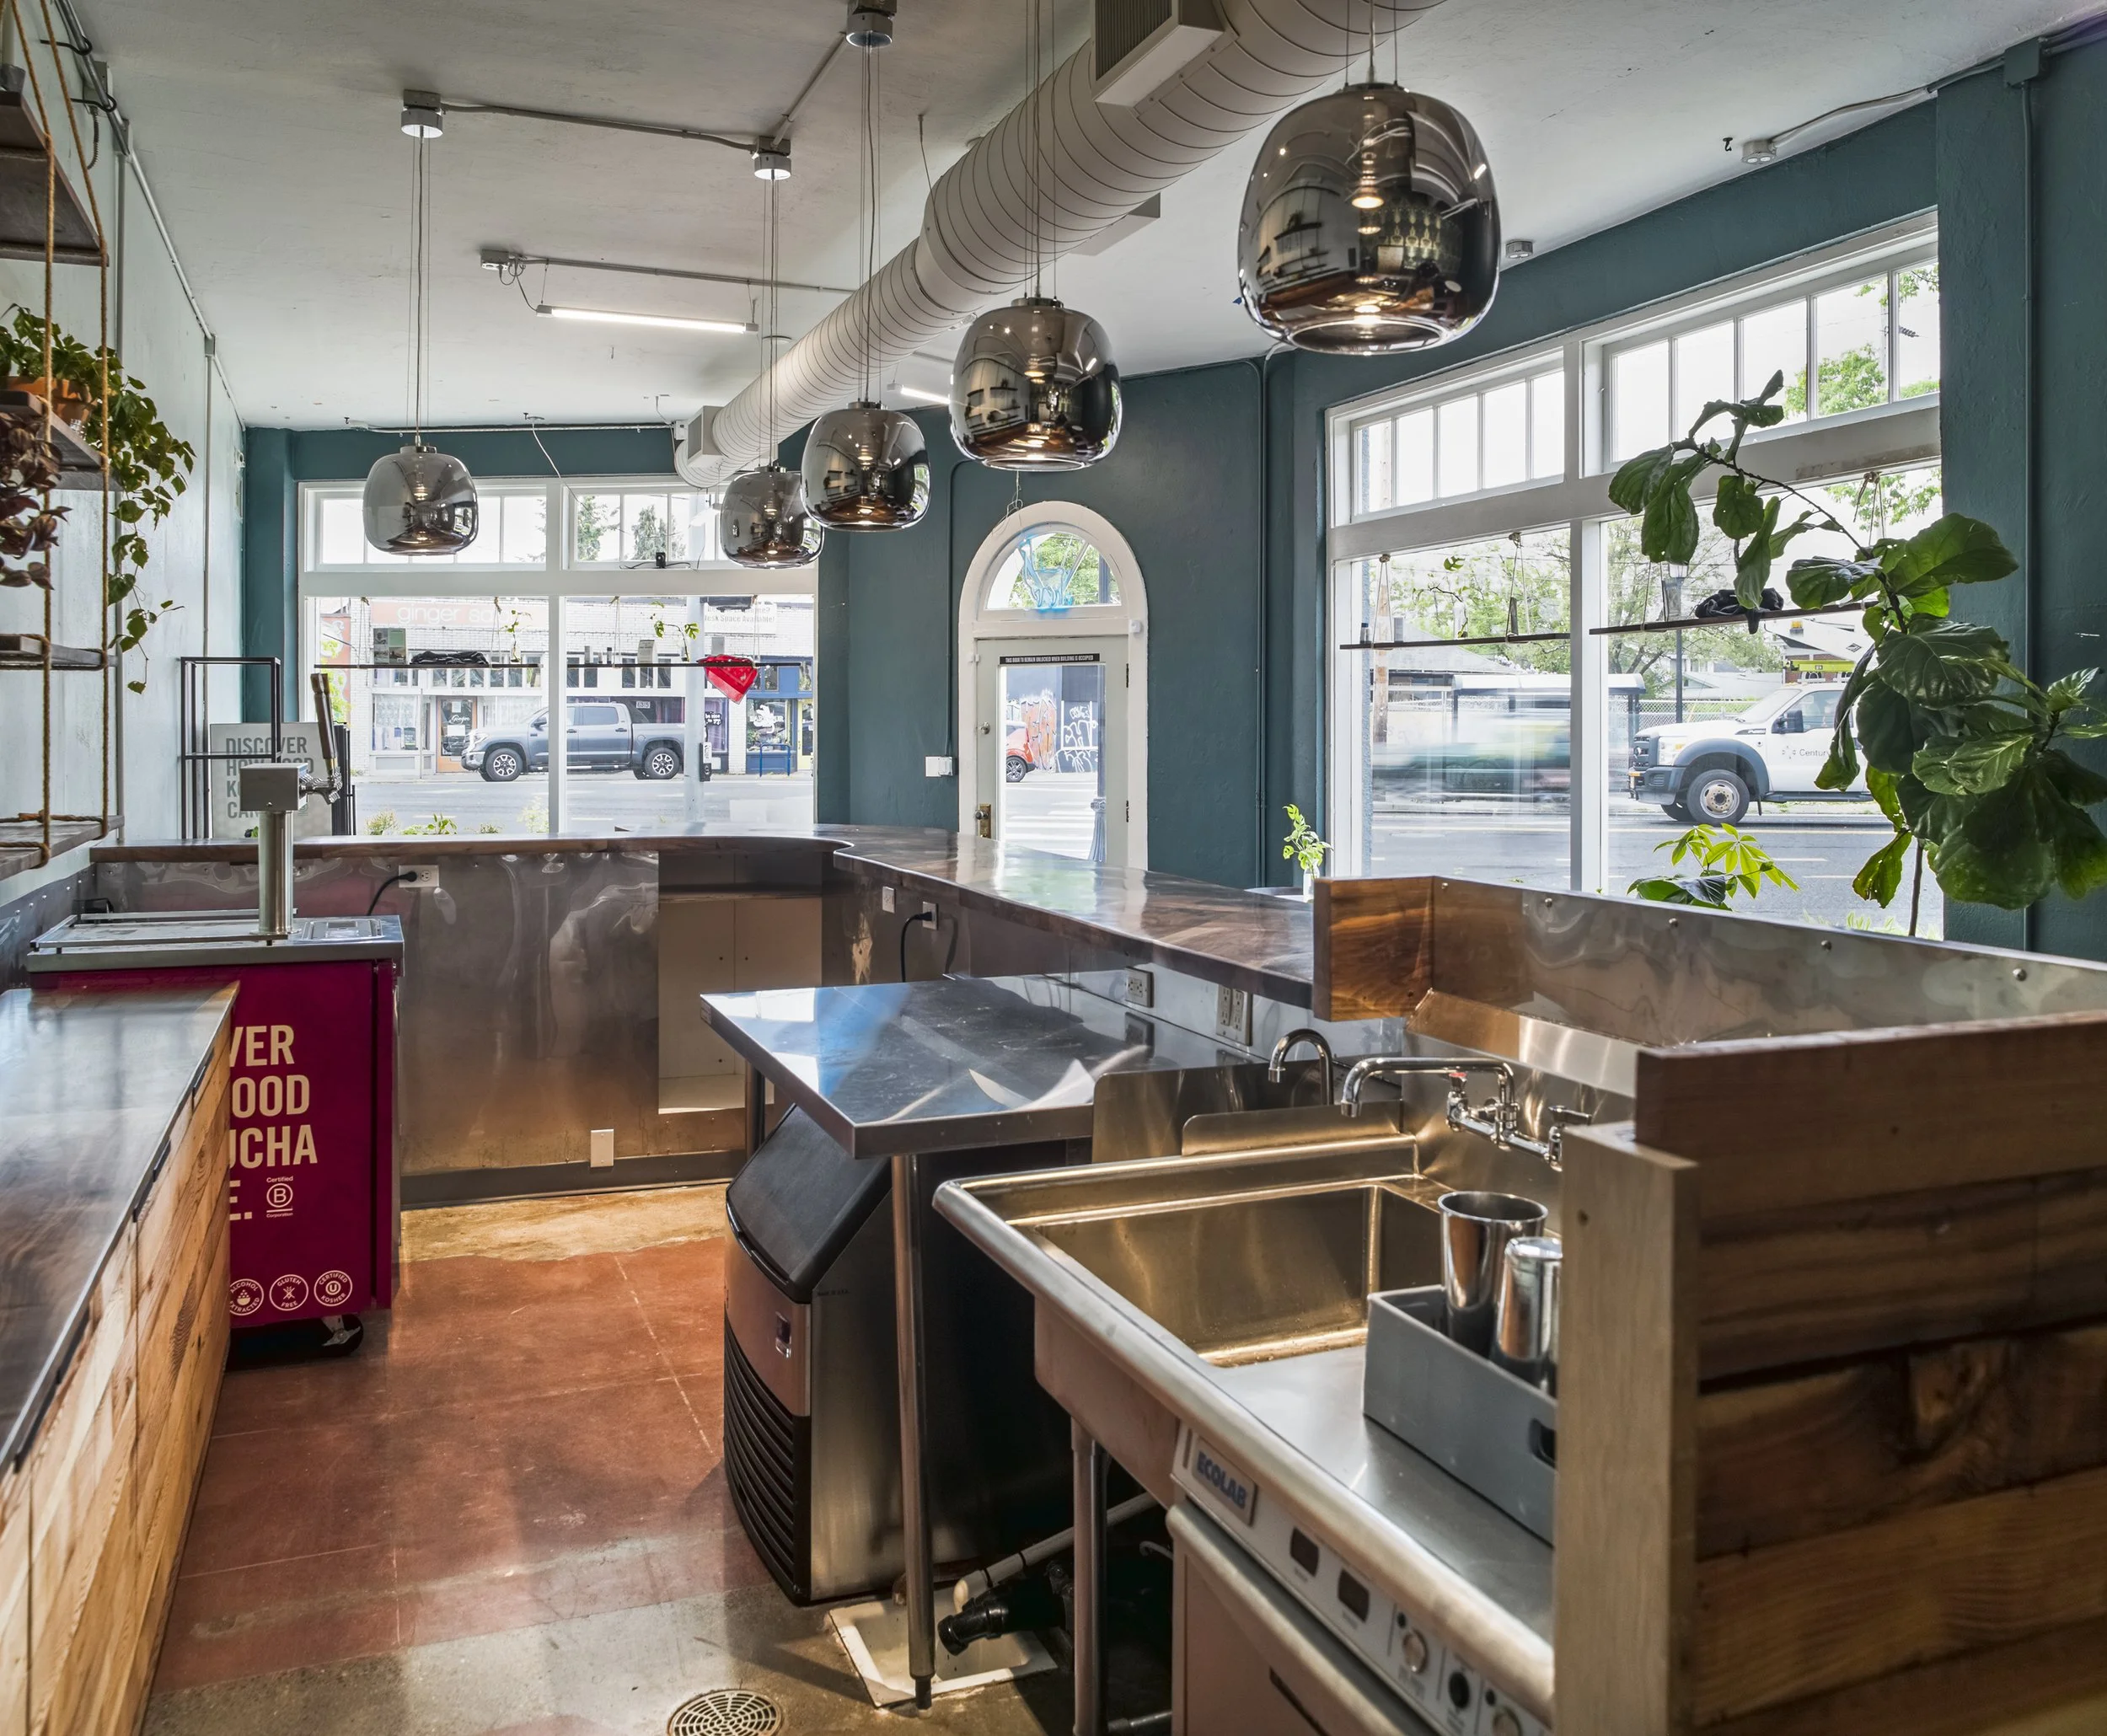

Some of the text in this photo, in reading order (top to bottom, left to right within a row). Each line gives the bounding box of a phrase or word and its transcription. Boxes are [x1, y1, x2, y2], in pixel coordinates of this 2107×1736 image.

[397, 604, 462, 624] ginger
[276, 1277, 302, 1287] GLUTEN
[319, 1273, 348, 1285] CERTIFIED
[230, 1281, 259, 1294] ALCOHOL
[320, 1293, 346, 1304] KOSHER
[1198, 1449, 1248, 1511] ECOLAB
